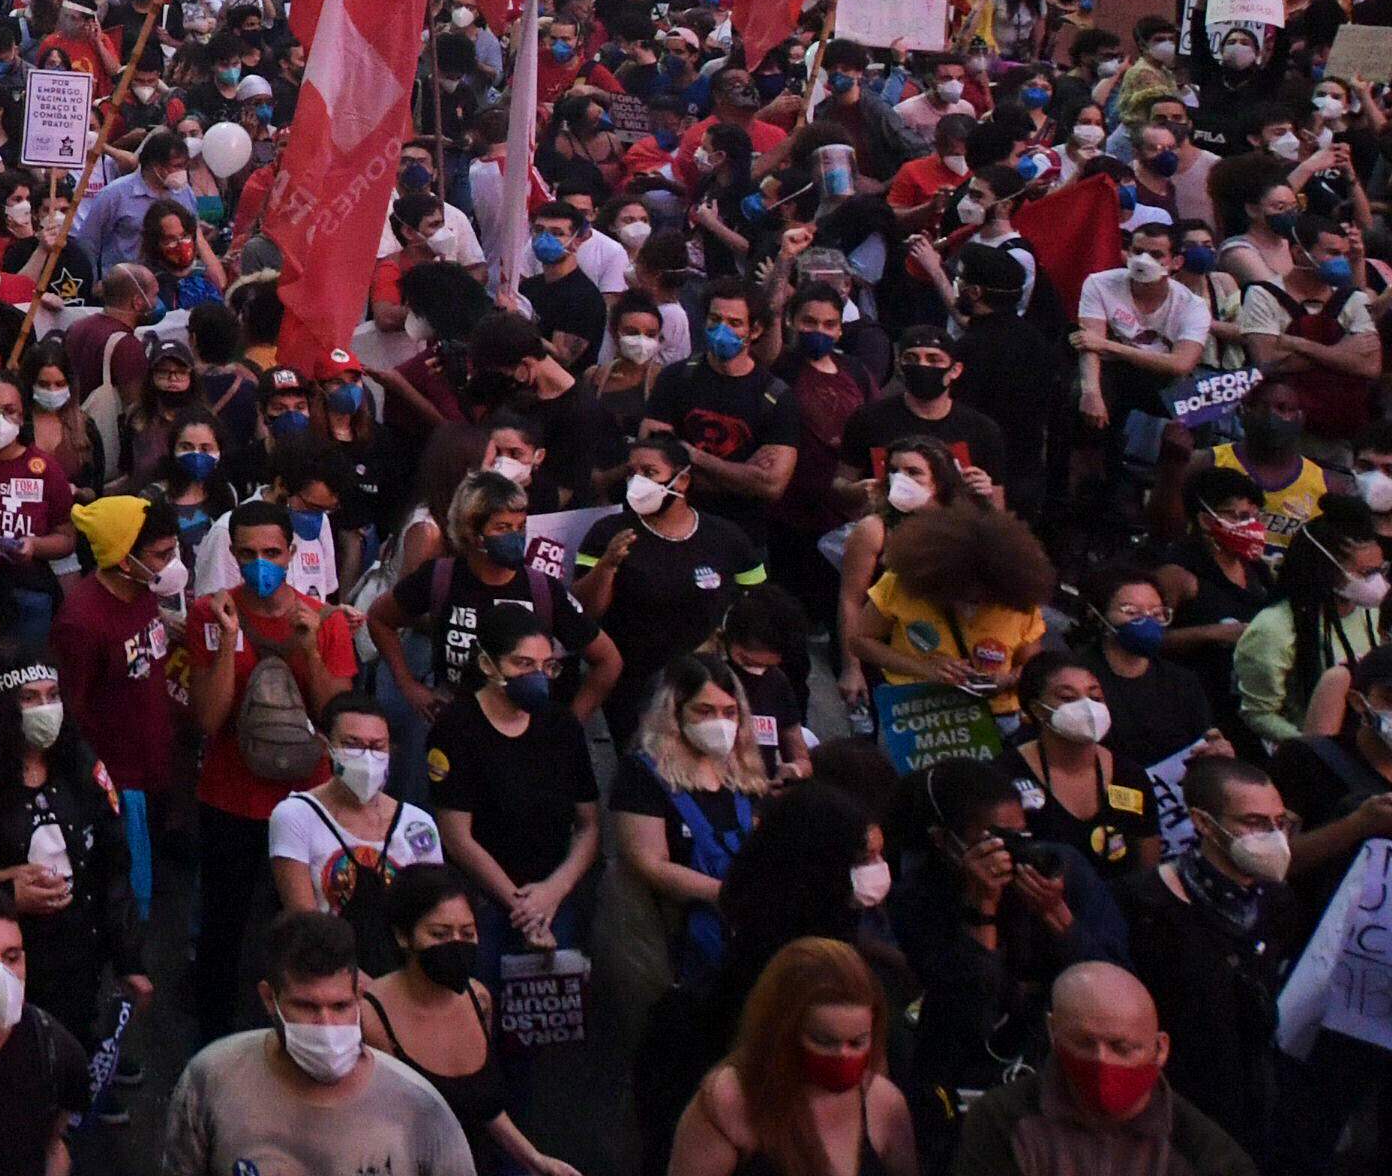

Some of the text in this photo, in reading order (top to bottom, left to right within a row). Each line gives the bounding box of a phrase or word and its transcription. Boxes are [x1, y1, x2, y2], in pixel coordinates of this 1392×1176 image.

[36, 95, 67, 103] VACINA
[33, 111, 67, 119] COMIDA
[1194, 130, 1226, 144] FILA
[1196, 368, 1263, 394] #FORA
[891, 705, 982, 733] CORTES
[915, 726, 973, 750] MAIS
[516, 1028, 584, 1045] FORA
